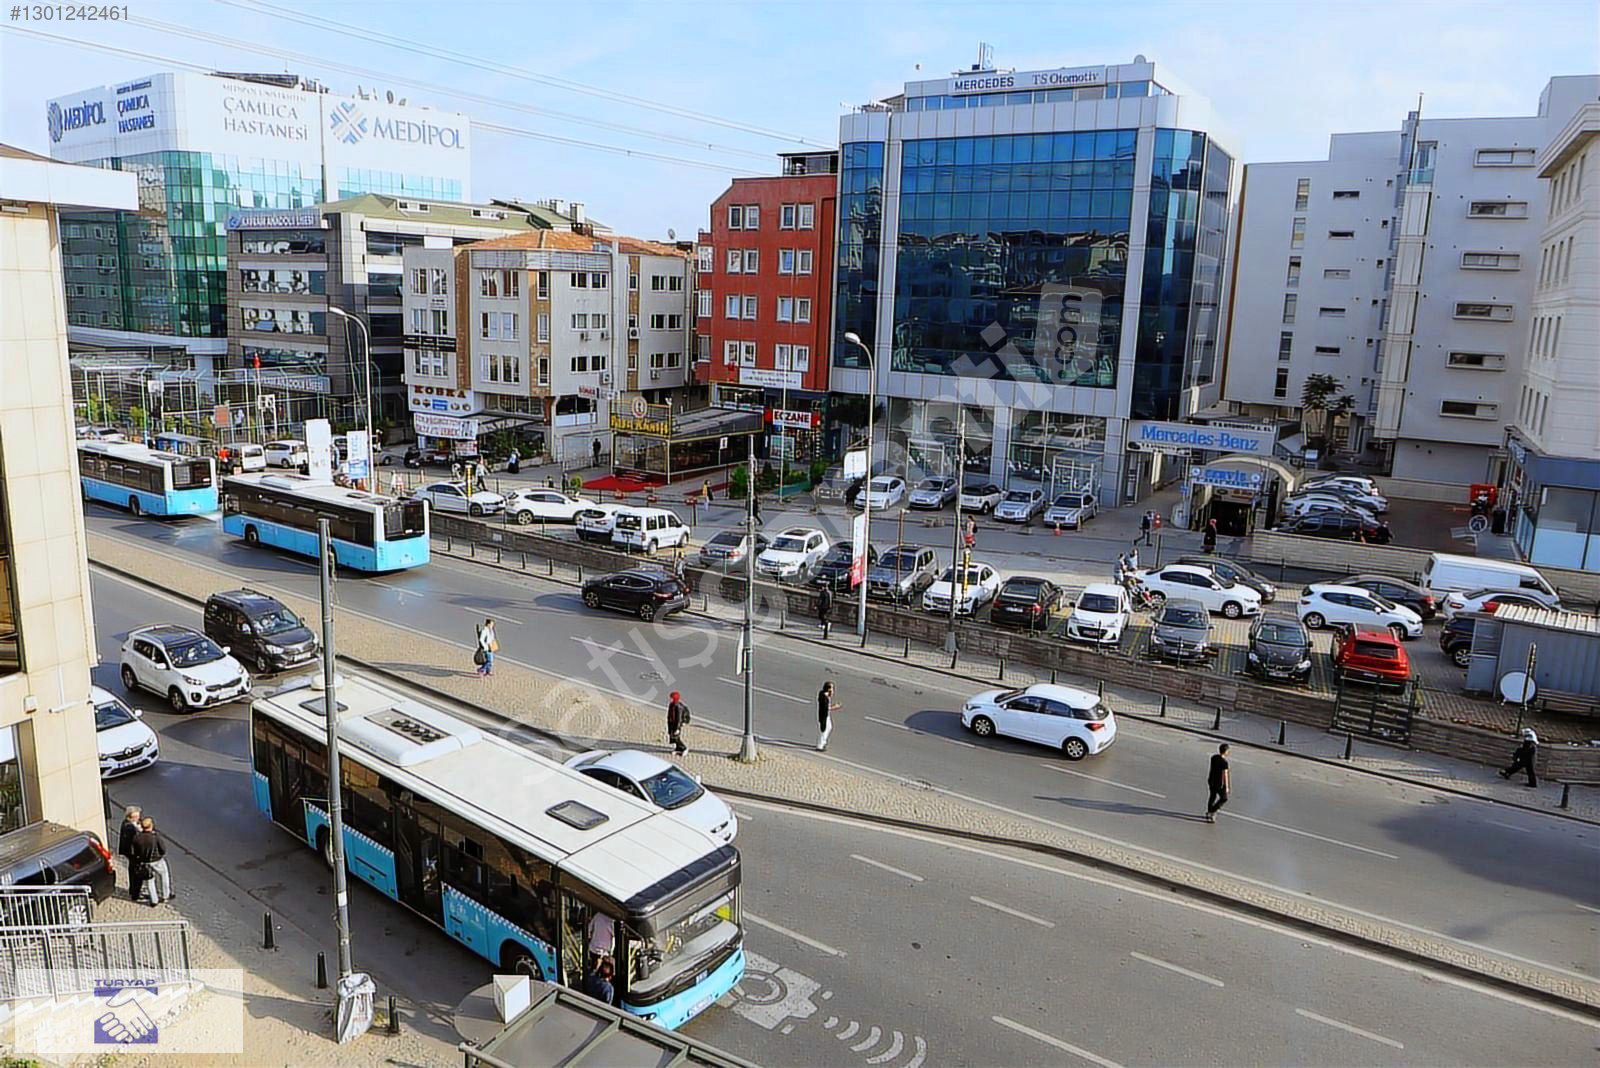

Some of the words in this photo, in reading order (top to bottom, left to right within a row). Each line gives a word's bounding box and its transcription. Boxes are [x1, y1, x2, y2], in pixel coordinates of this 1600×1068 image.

[954, 76, 1015, 91] MERCEDES
[1032, 73, 1048, 85] TS
[1049, 70, 1099, 84] Otomotiv
[63, 100, 106, 131] MEDİPOL
[223, 97, 299, 121] ÇAMLICA
[224, 117, 309, 142] HASTANESİ
[373, 116, 465, 150] MEDİPOL
[1141, 425, 1259, 451] Mercedes-Benz
